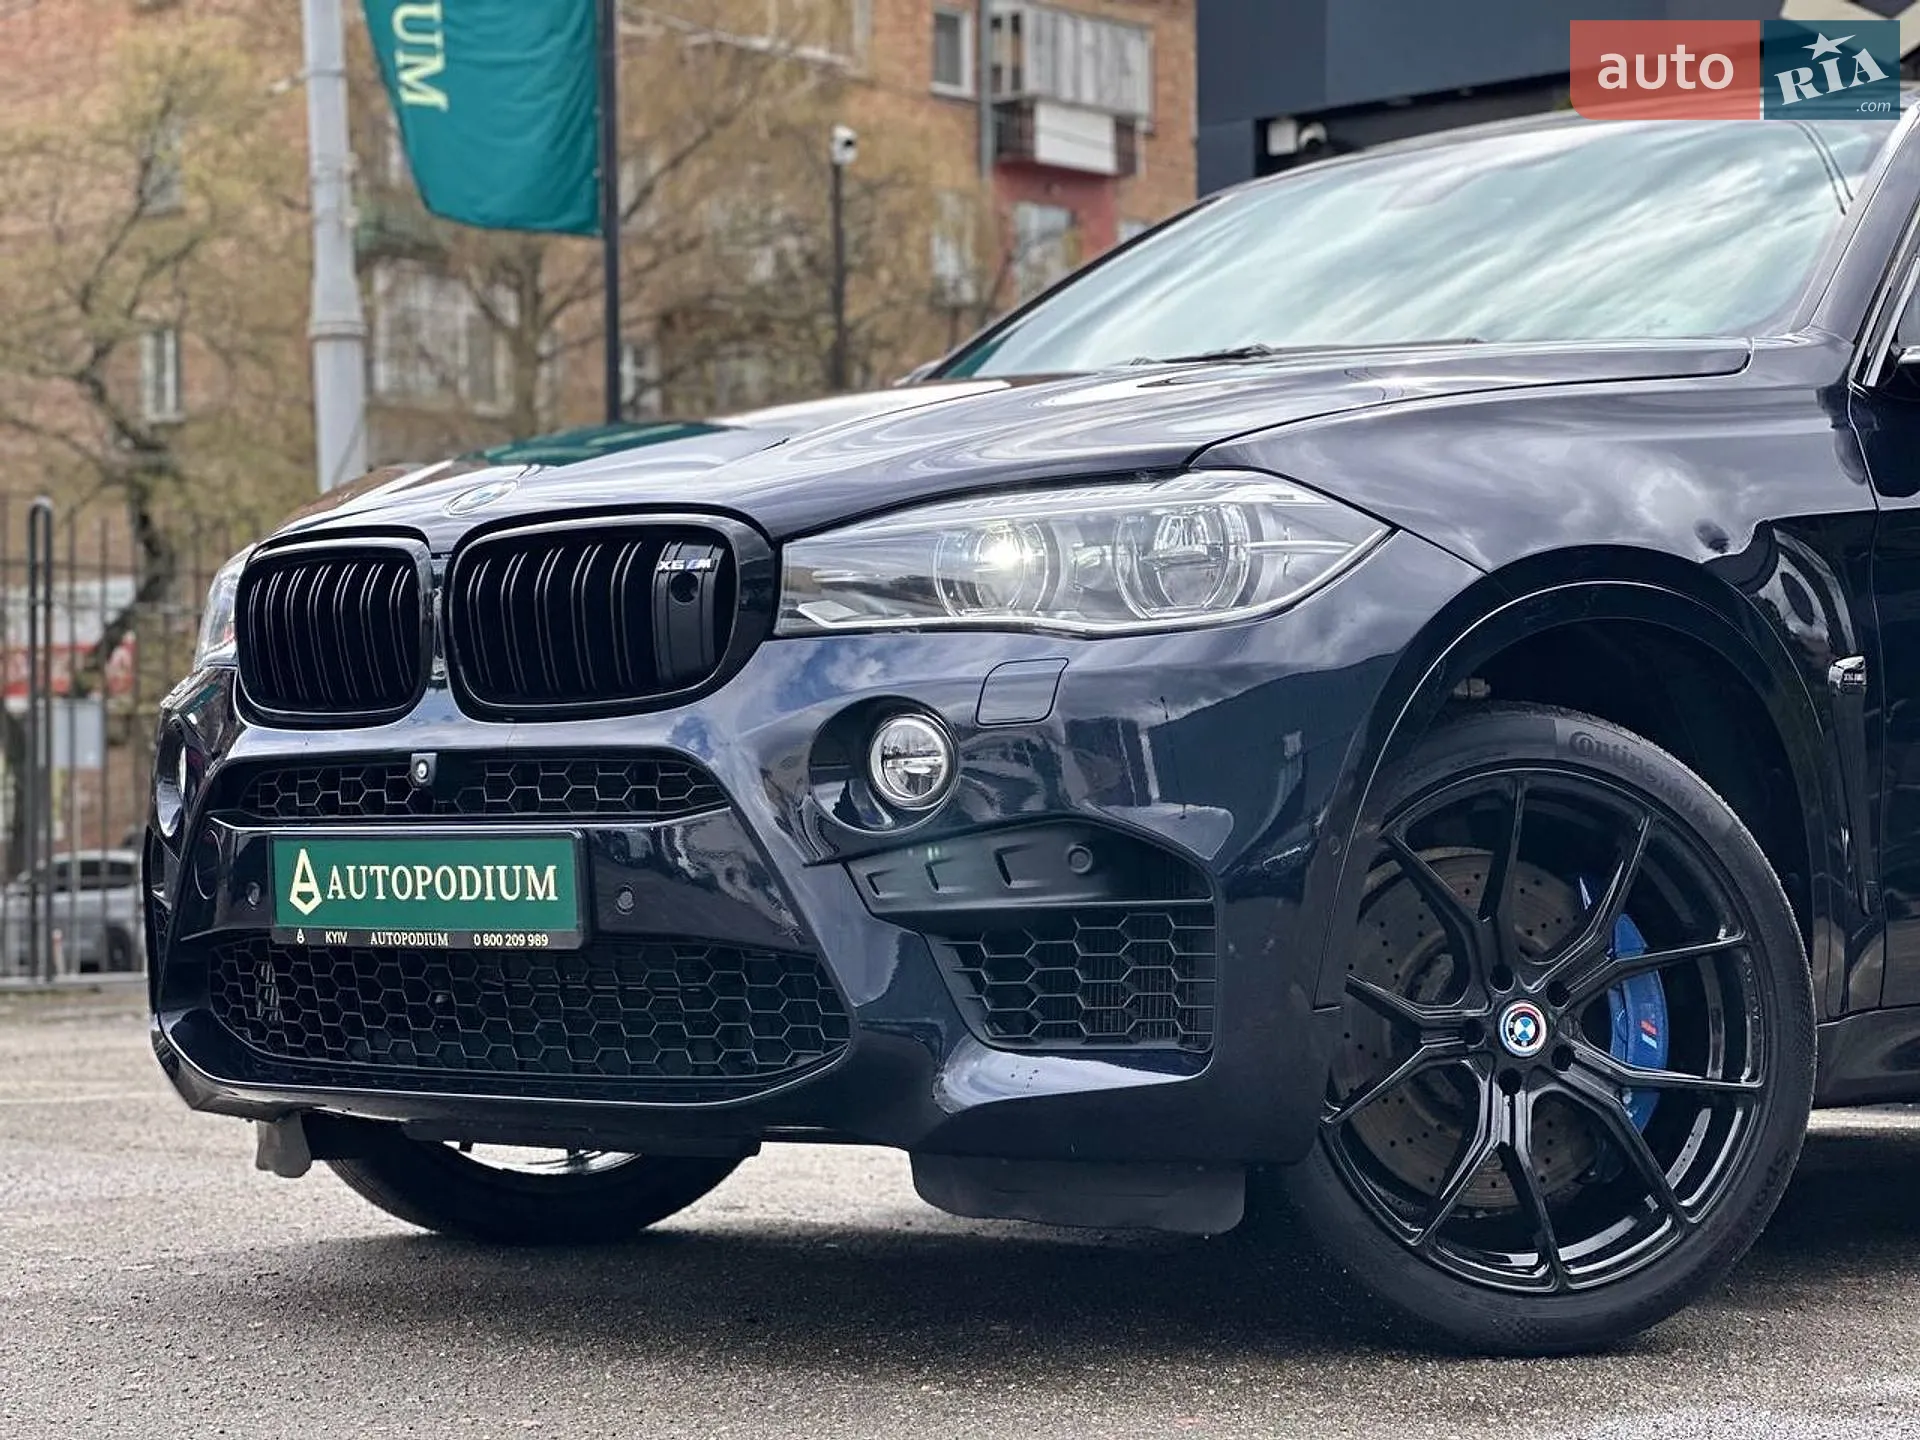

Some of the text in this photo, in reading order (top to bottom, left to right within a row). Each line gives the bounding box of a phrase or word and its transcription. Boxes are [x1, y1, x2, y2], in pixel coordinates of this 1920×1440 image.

[327, 865, 559, 901] AUTOPODIUM
[325, 931, 549, 946] KYIV AUTOPODIUM 0 800 209 989
